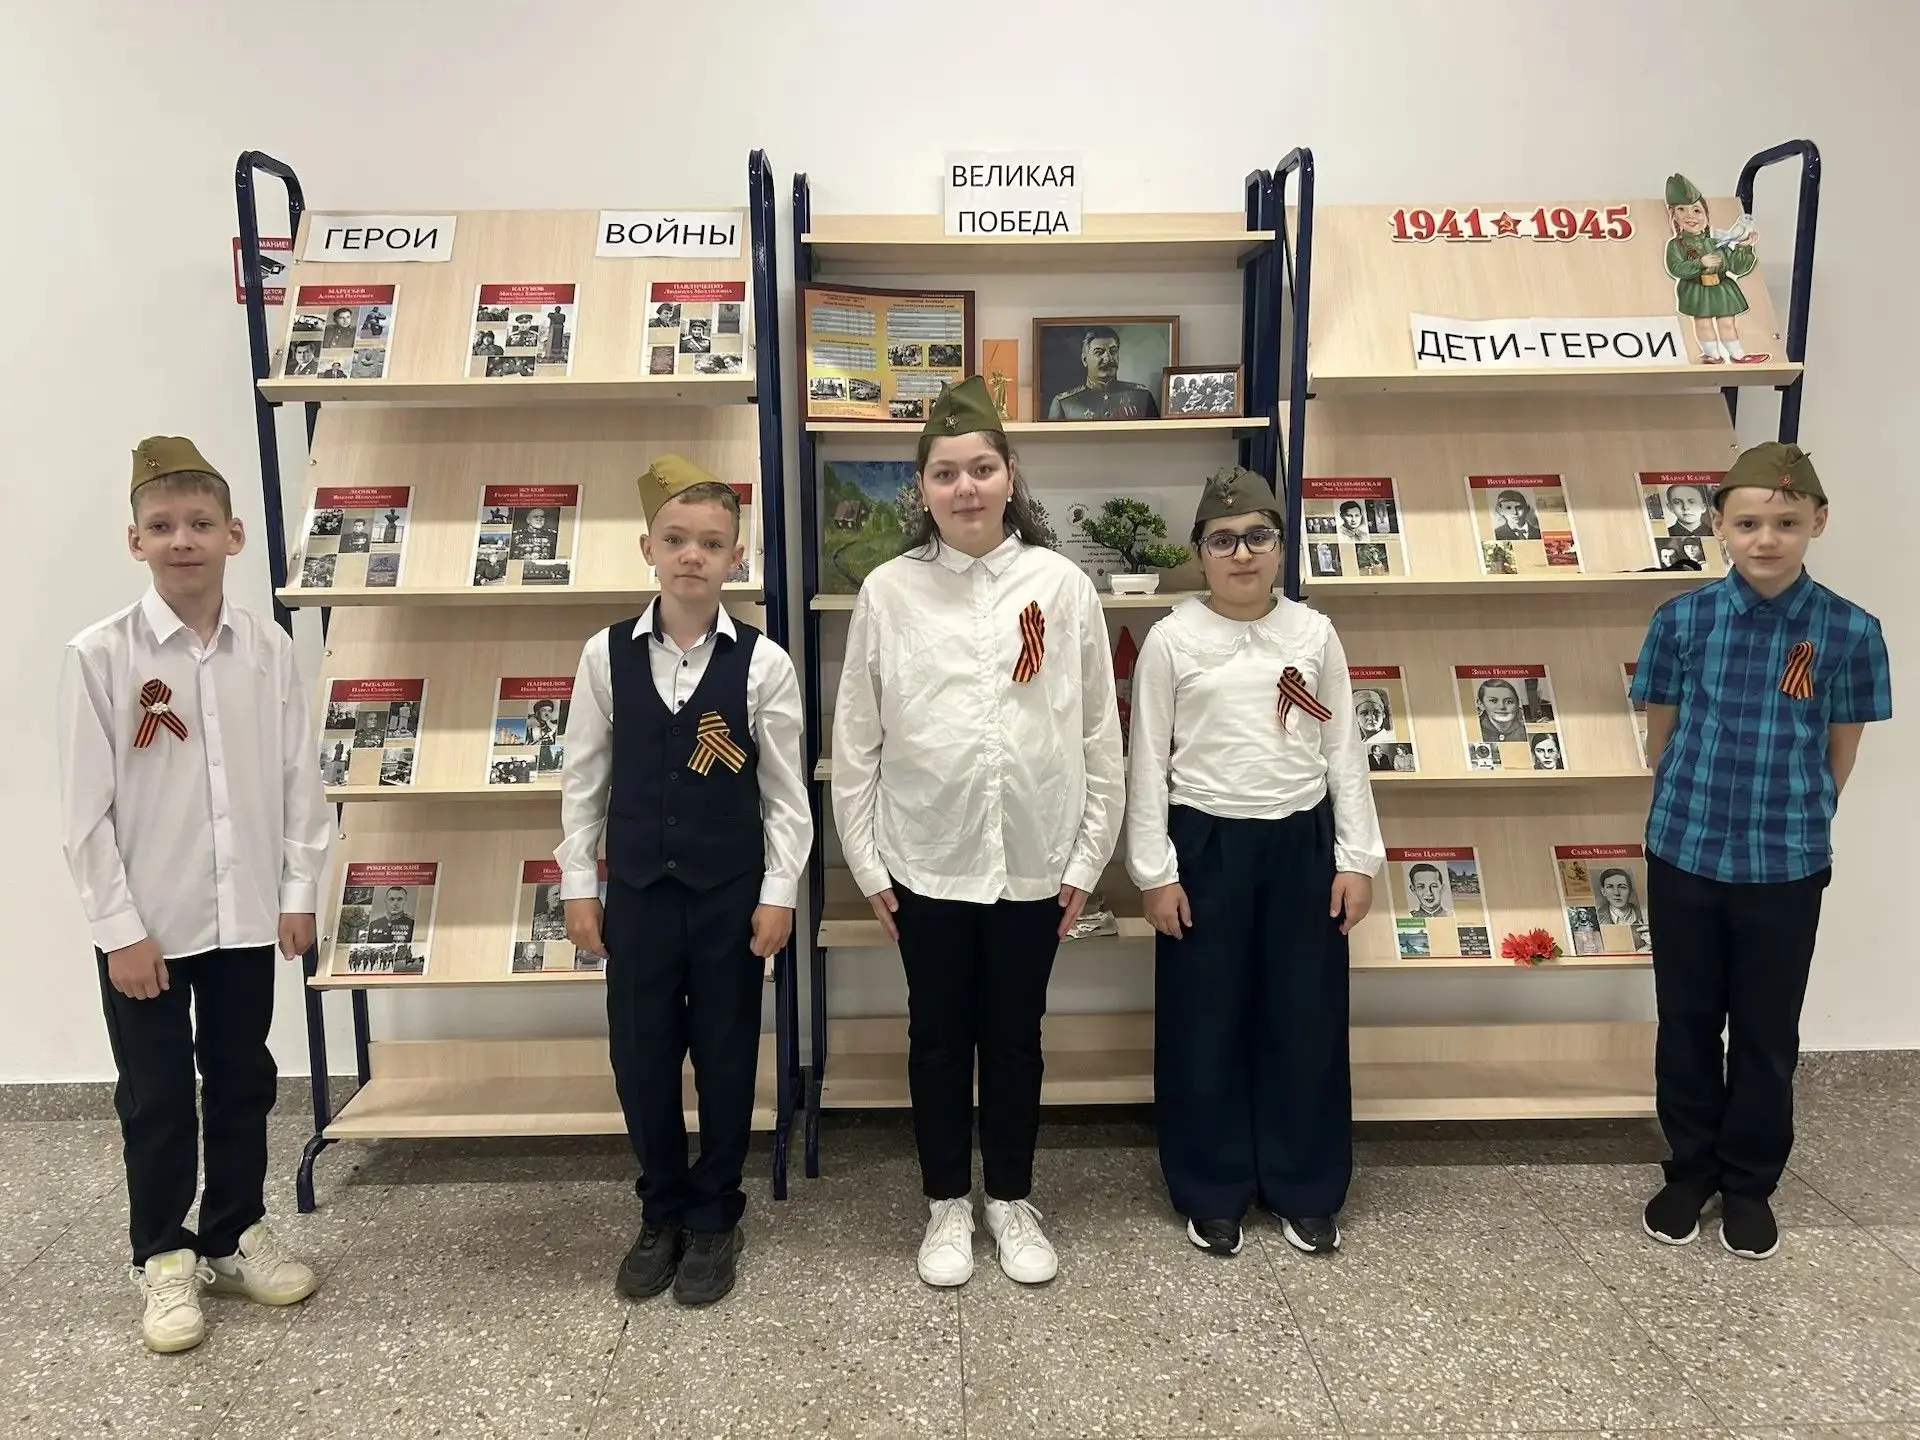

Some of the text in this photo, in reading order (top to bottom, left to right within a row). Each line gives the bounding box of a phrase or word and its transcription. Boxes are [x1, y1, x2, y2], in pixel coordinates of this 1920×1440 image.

[952, 165, 1075, 187] ВЕЛИКАЯ
[324, 218, 735, 250] ГЕРОИ ВОЙНЫ
[959, 211, 1069, 235] ПОБЕДА
[1392, 206, 1634, 240] 1941 1945
[258, 240, 289, 249] МАНИЕ!
[1418, 329, 1677, 364] ДЕТИ-ГЕРОИ
